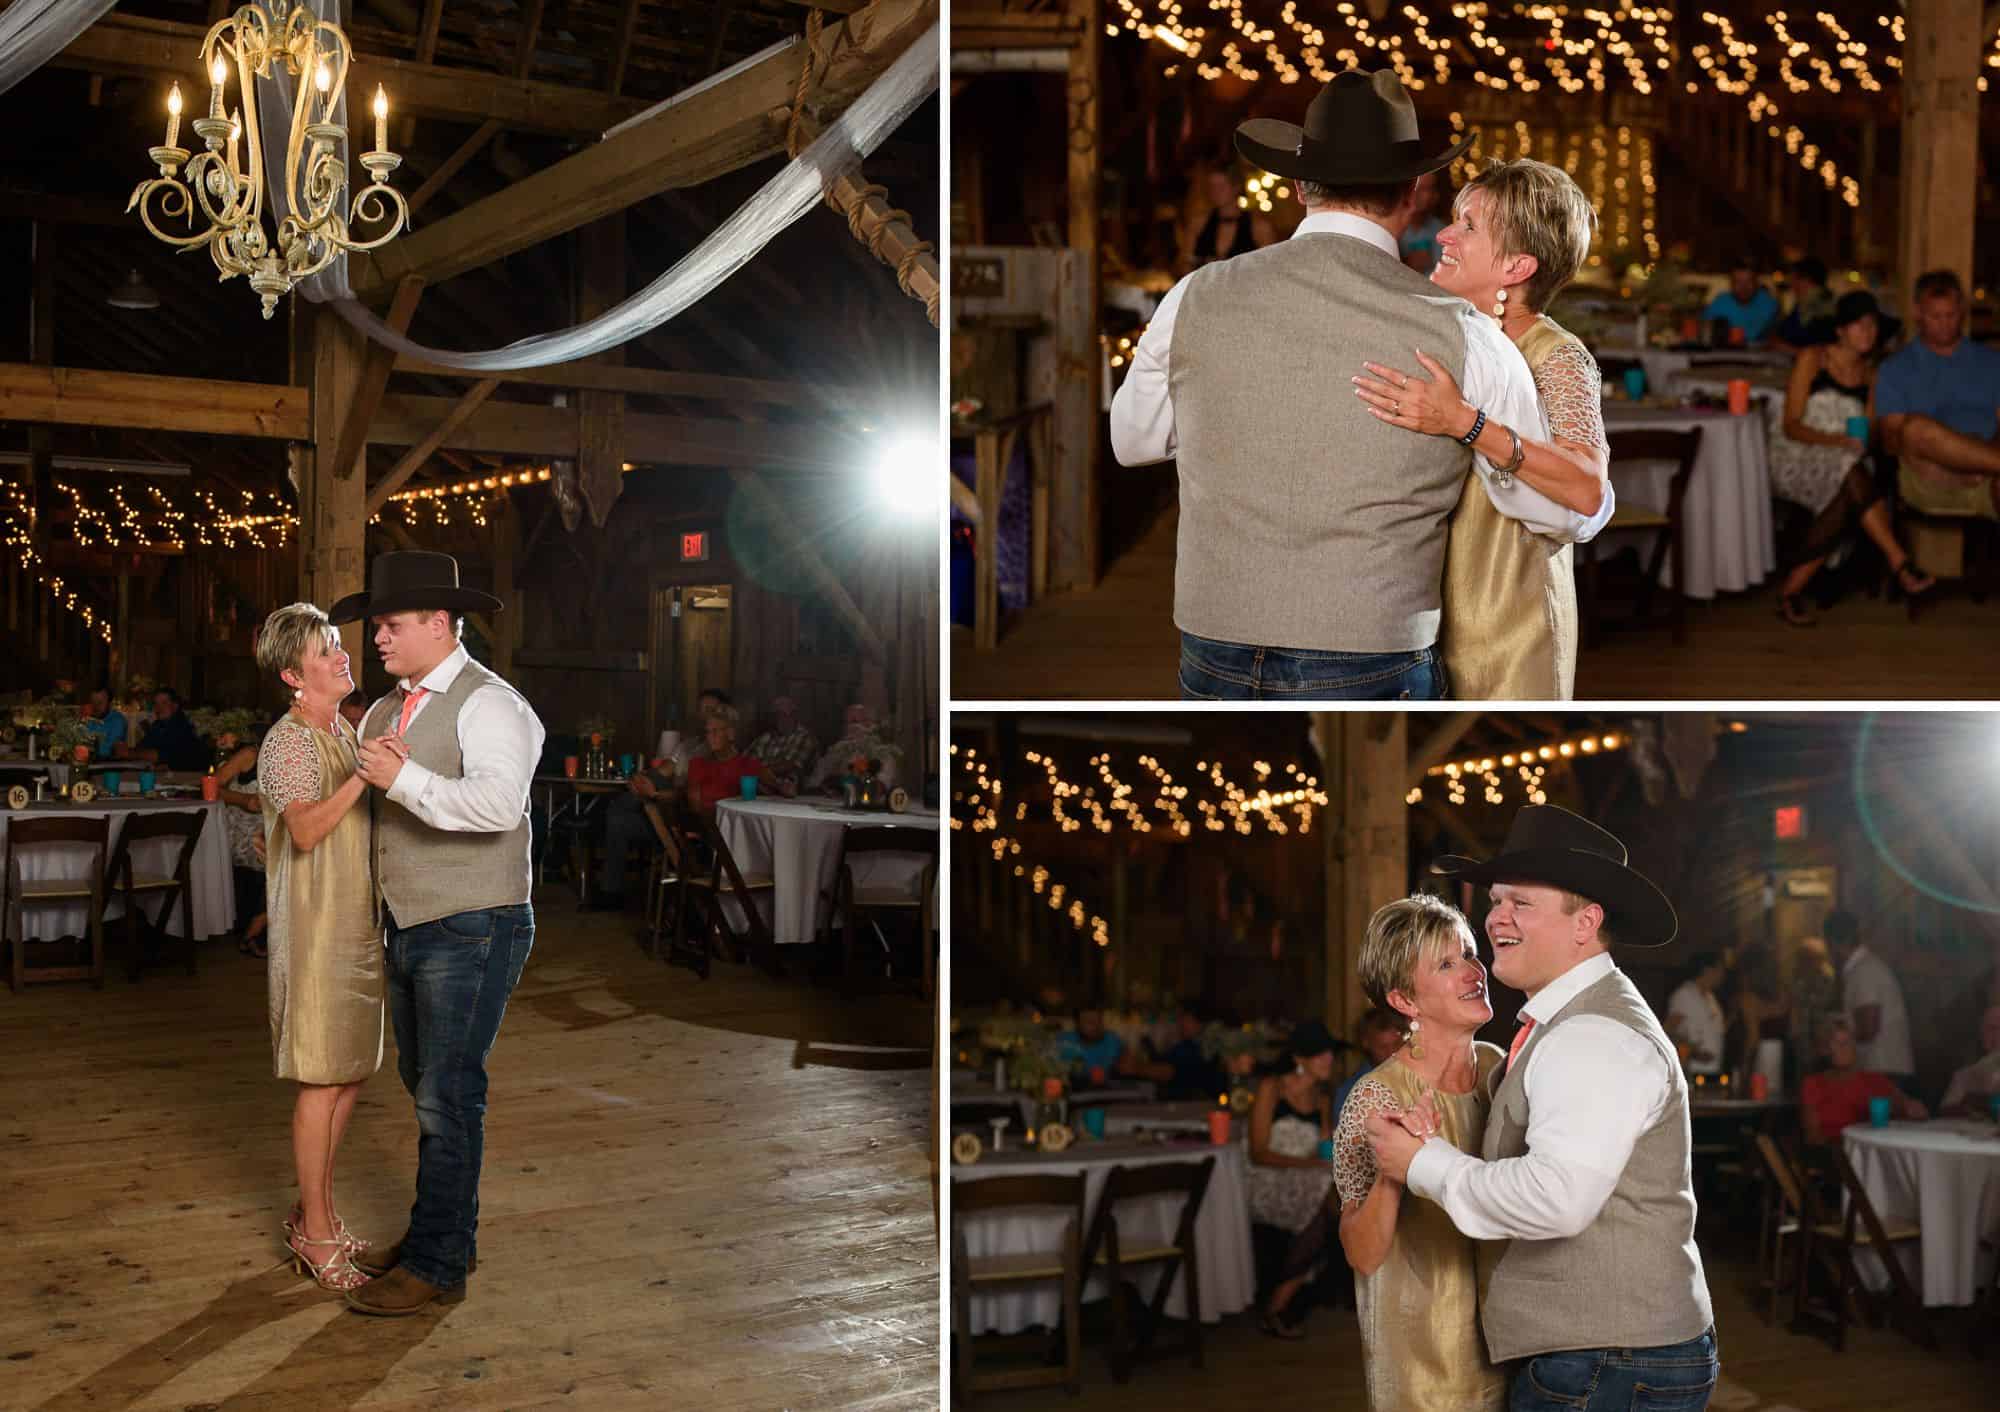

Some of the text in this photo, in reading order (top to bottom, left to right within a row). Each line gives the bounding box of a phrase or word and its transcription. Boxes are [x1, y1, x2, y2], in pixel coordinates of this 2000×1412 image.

[684, 534, 702, 558] EXIT
[77, 784, 89, 796] 15
[14, 791, 24, 802] 16
